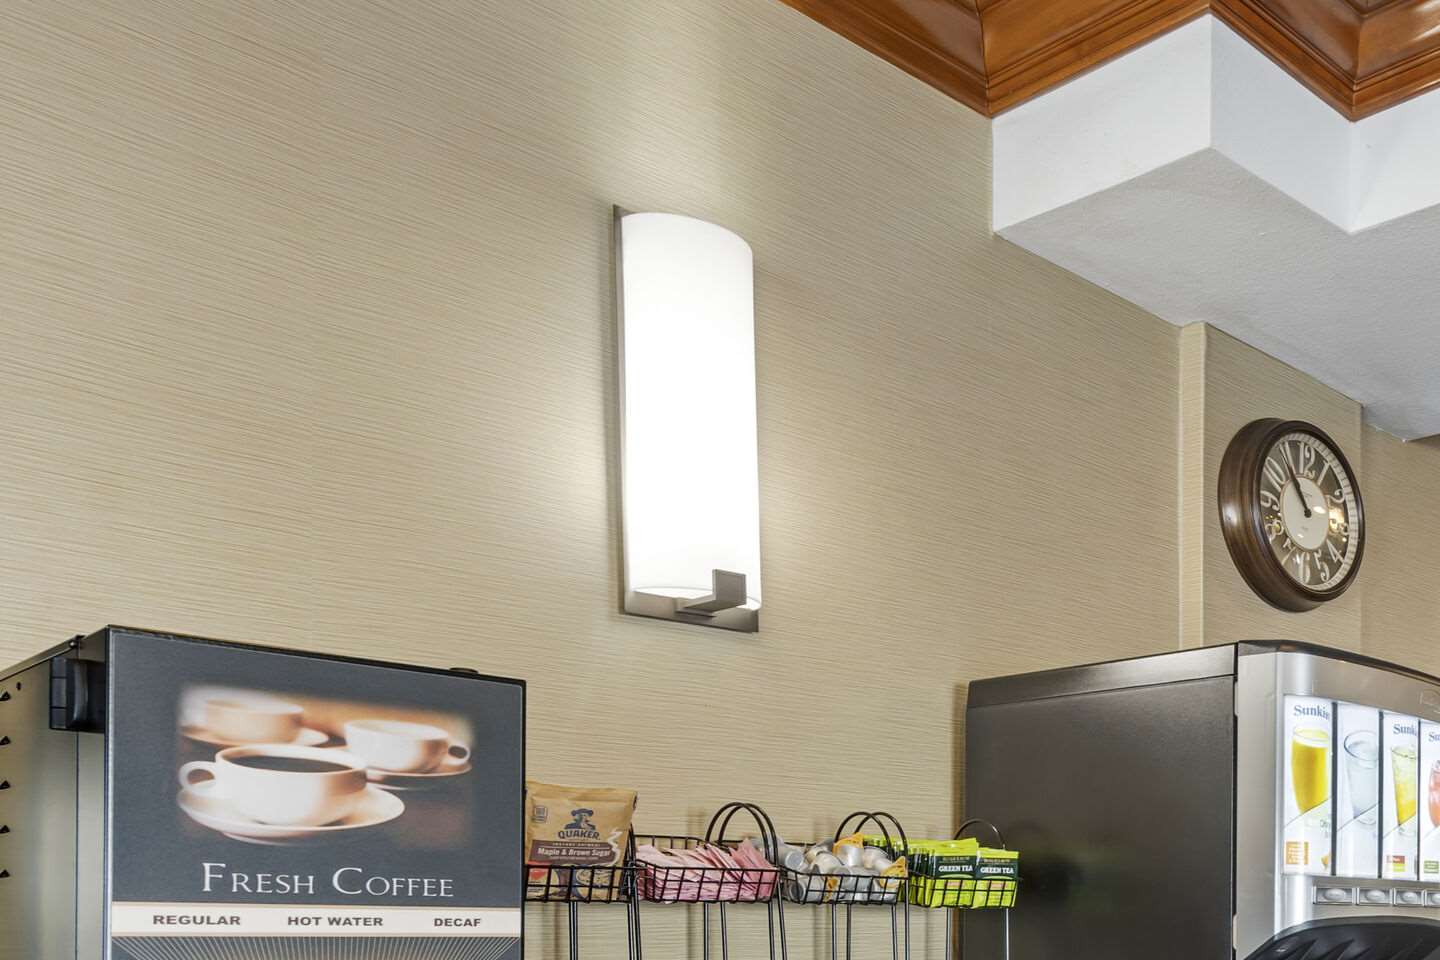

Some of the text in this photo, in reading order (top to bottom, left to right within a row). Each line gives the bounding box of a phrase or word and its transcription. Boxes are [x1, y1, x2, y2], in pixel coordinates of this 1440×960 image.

[1297, 440, 1316, 479] 12
[557, 830, 601, 841] QUAKER
[537, 847, 611, 858] Maple & Brown Sugar
[938, 864, 974, 873] GREEN TEA
[980, 866, 1014, 875] GREEN TEA
[202, 862, 454, 897] FRESH COFFEE
[152, 914, 481, 928] REGULAR HOT WATER DECAF
